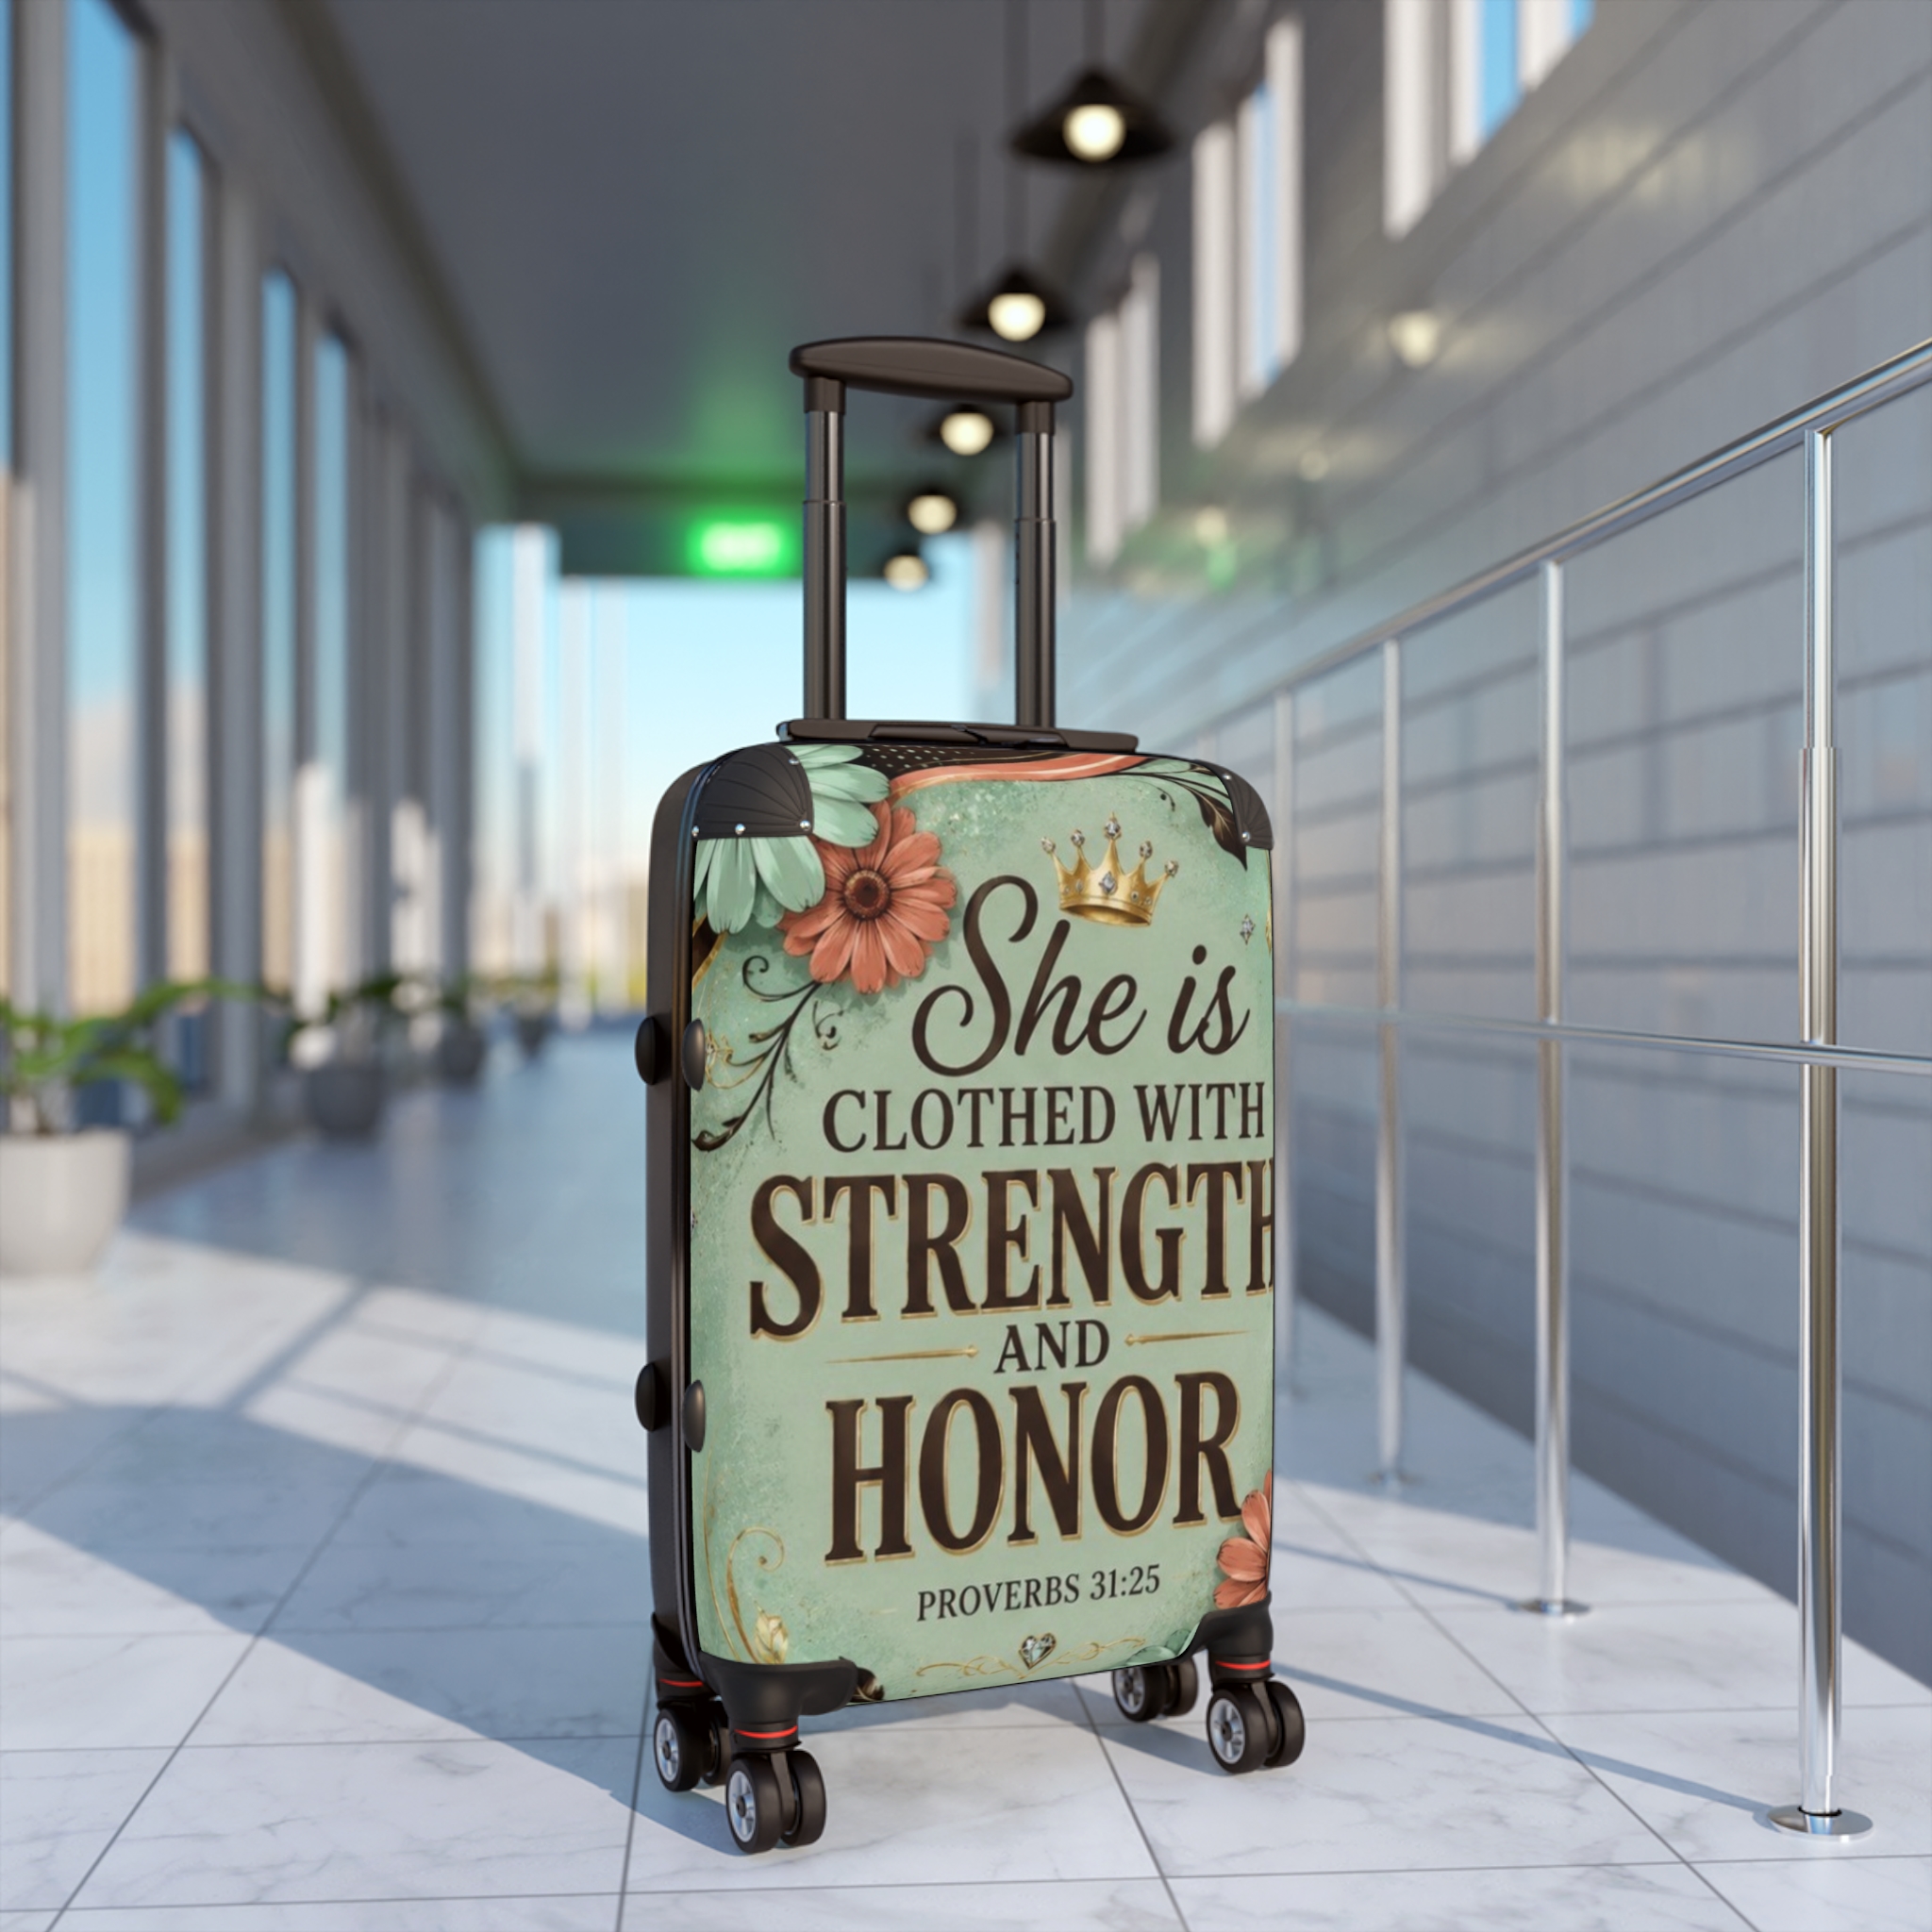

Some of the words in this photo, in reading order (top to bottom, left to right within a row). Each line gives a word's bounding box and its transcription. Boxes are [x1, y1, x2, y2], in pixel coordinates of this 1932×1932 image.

[912, 874, 1148, 1077] She
[1168, 944, 1251, 1055] is
[823, 1086, 1116, 1153] CLOTHED
[1135, 1081, 1266, 1142] WITH
[993, 1319, 1110, 1374] AND
[824, 1371, 1243, 1566] HONOR
[917, 1573, 1081, 1622] PROVERBS
[1090, 1563, 1162, 1601] 31:25
